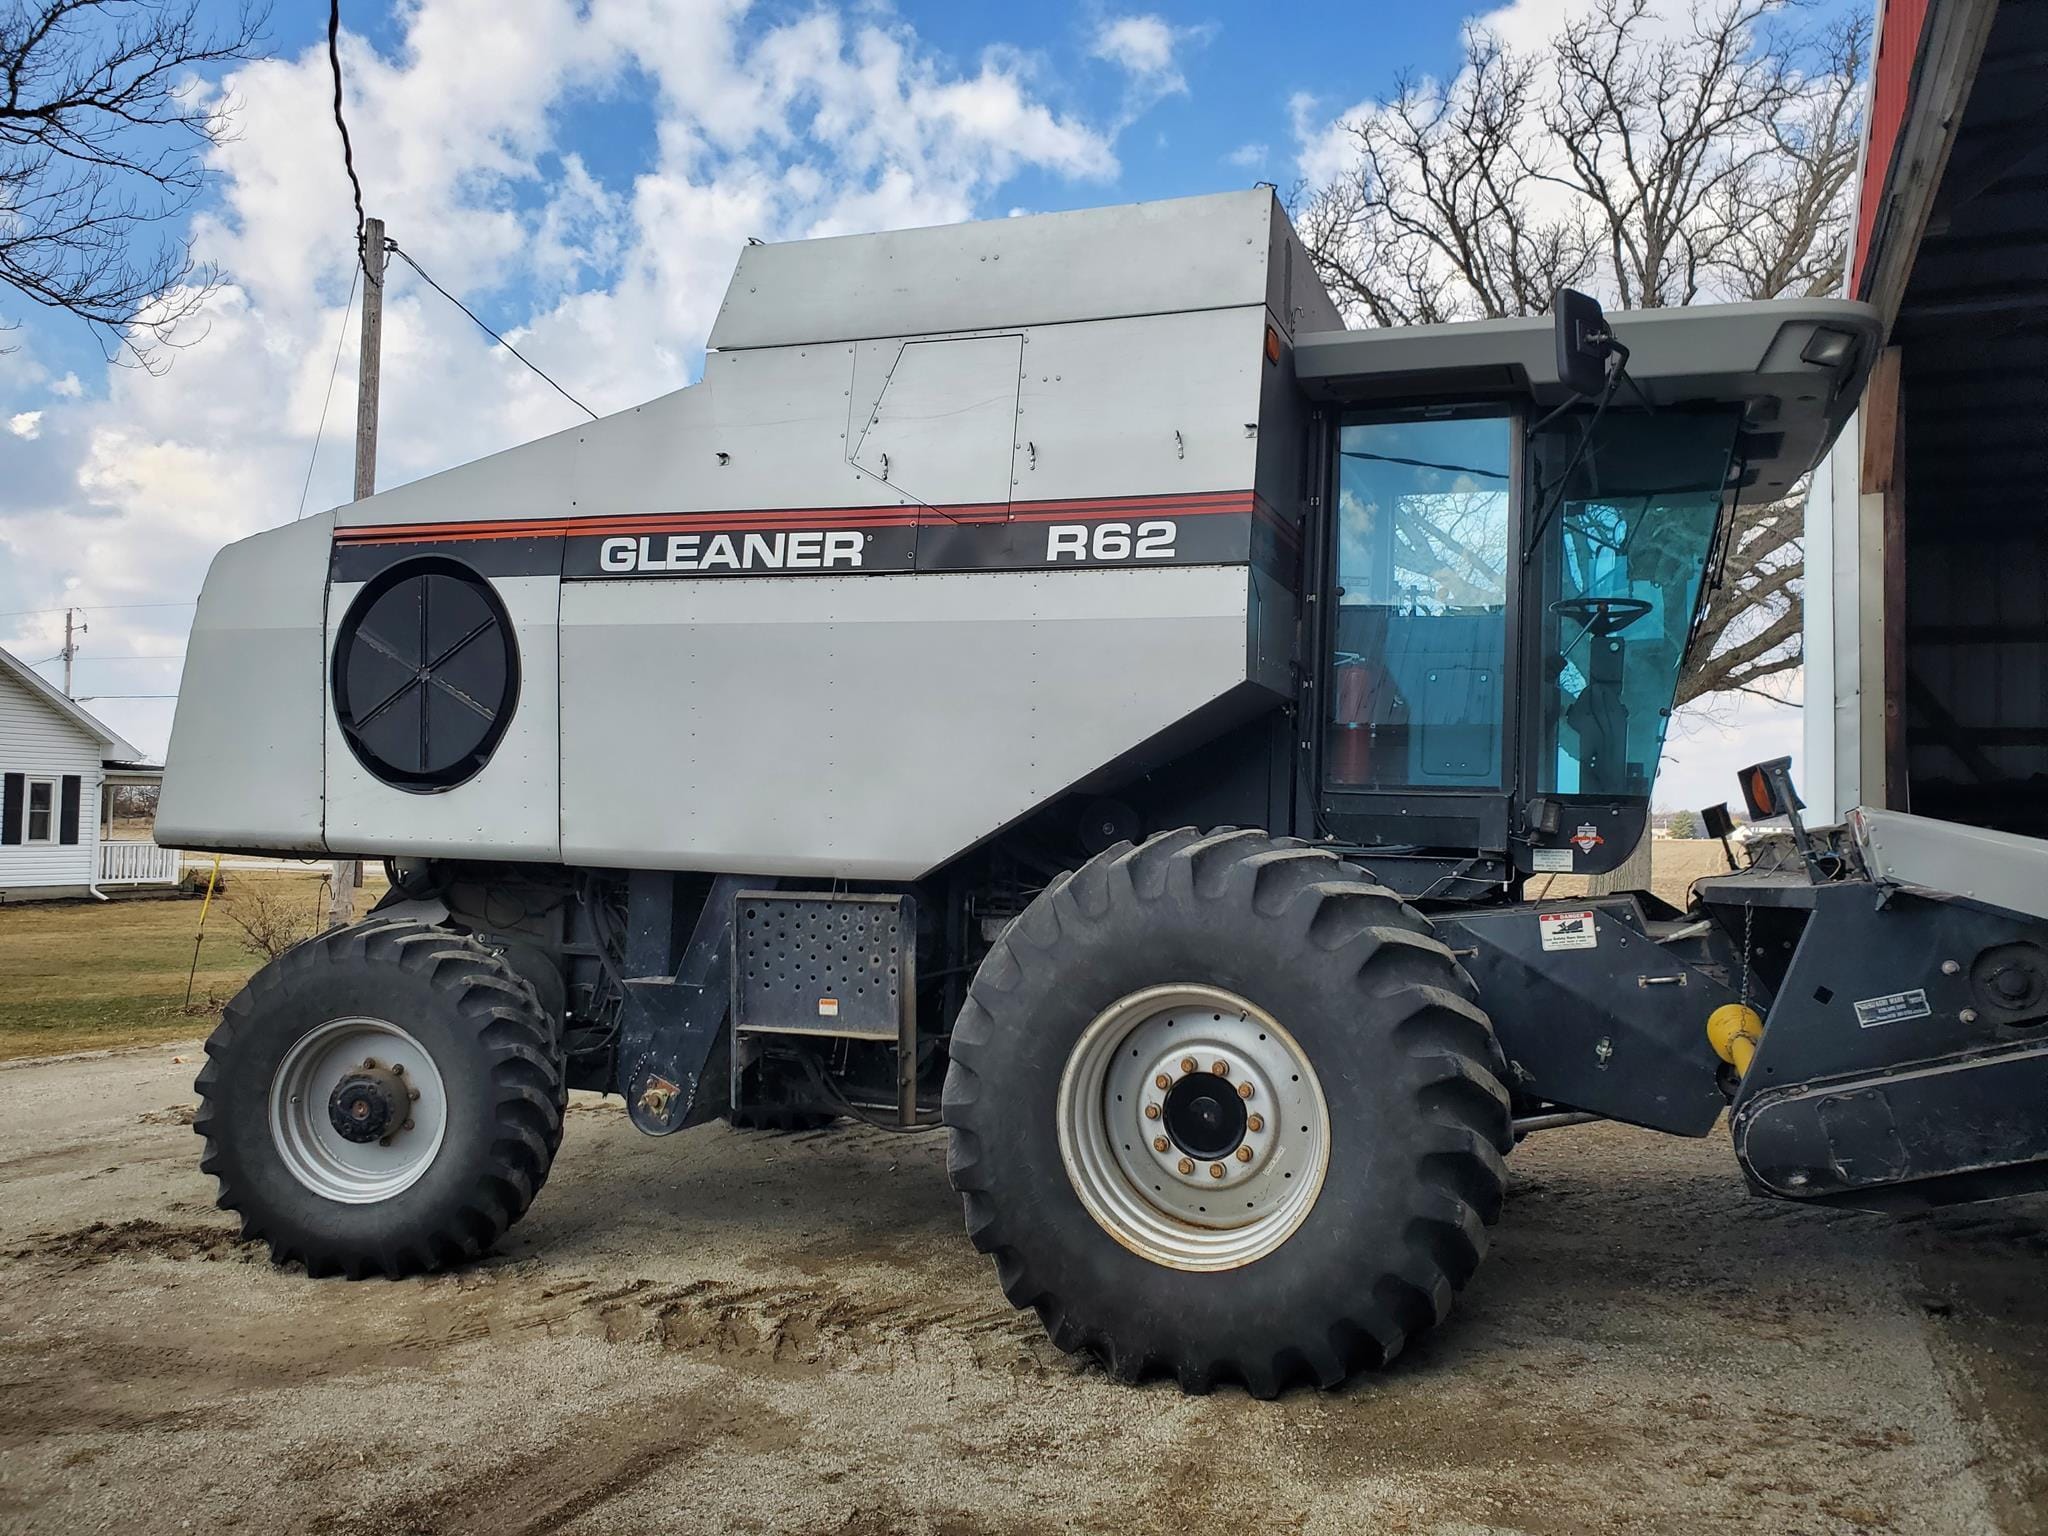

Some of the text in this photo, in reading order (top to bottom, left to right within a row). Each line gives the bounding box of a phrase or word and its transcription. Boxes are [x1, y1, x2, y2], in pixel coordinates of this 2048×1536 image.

[600, 531, 865, 572] GLEANER
[1046, 520, 1177, 561] R62
[1560, 911, 1584, 920] DANGER
